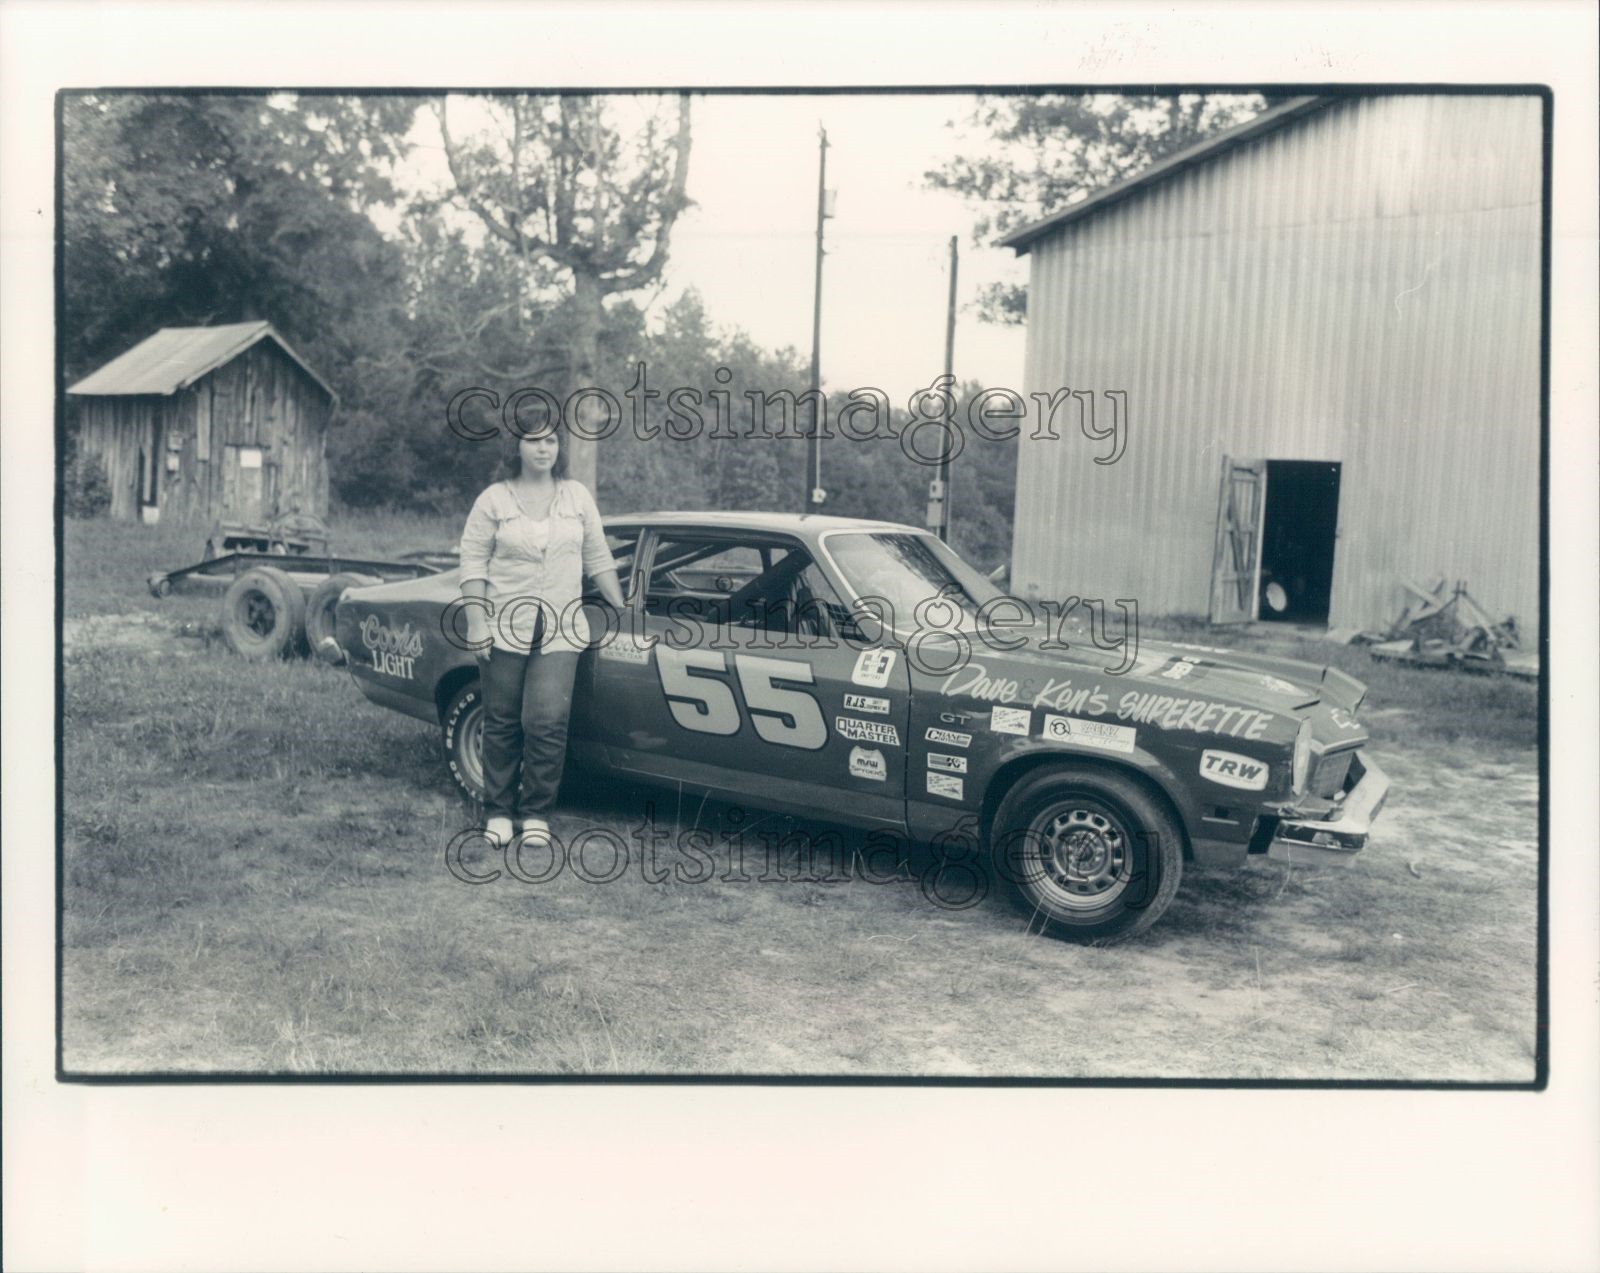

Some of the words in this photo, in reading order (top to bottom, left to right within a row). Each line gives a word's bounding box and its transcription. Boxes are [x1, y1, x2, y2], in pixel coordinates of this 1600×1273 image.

[359, 614, 424, 657] Coors
[372, 650, 415, 679] LIGHT
[655, 643, 829, 750] 55
[940, 663, 1018, 703] Dave
[1033, 678, 1108, 716] Ken's
[1117, 691, 1274, 740] SUPERETTE
[837, 718, 895, 735] QUARTER
[940, 712, 972, 725] GT
[847, 728, 897, 744] MASTER
[1205, 755, 1264, 780] TRW
